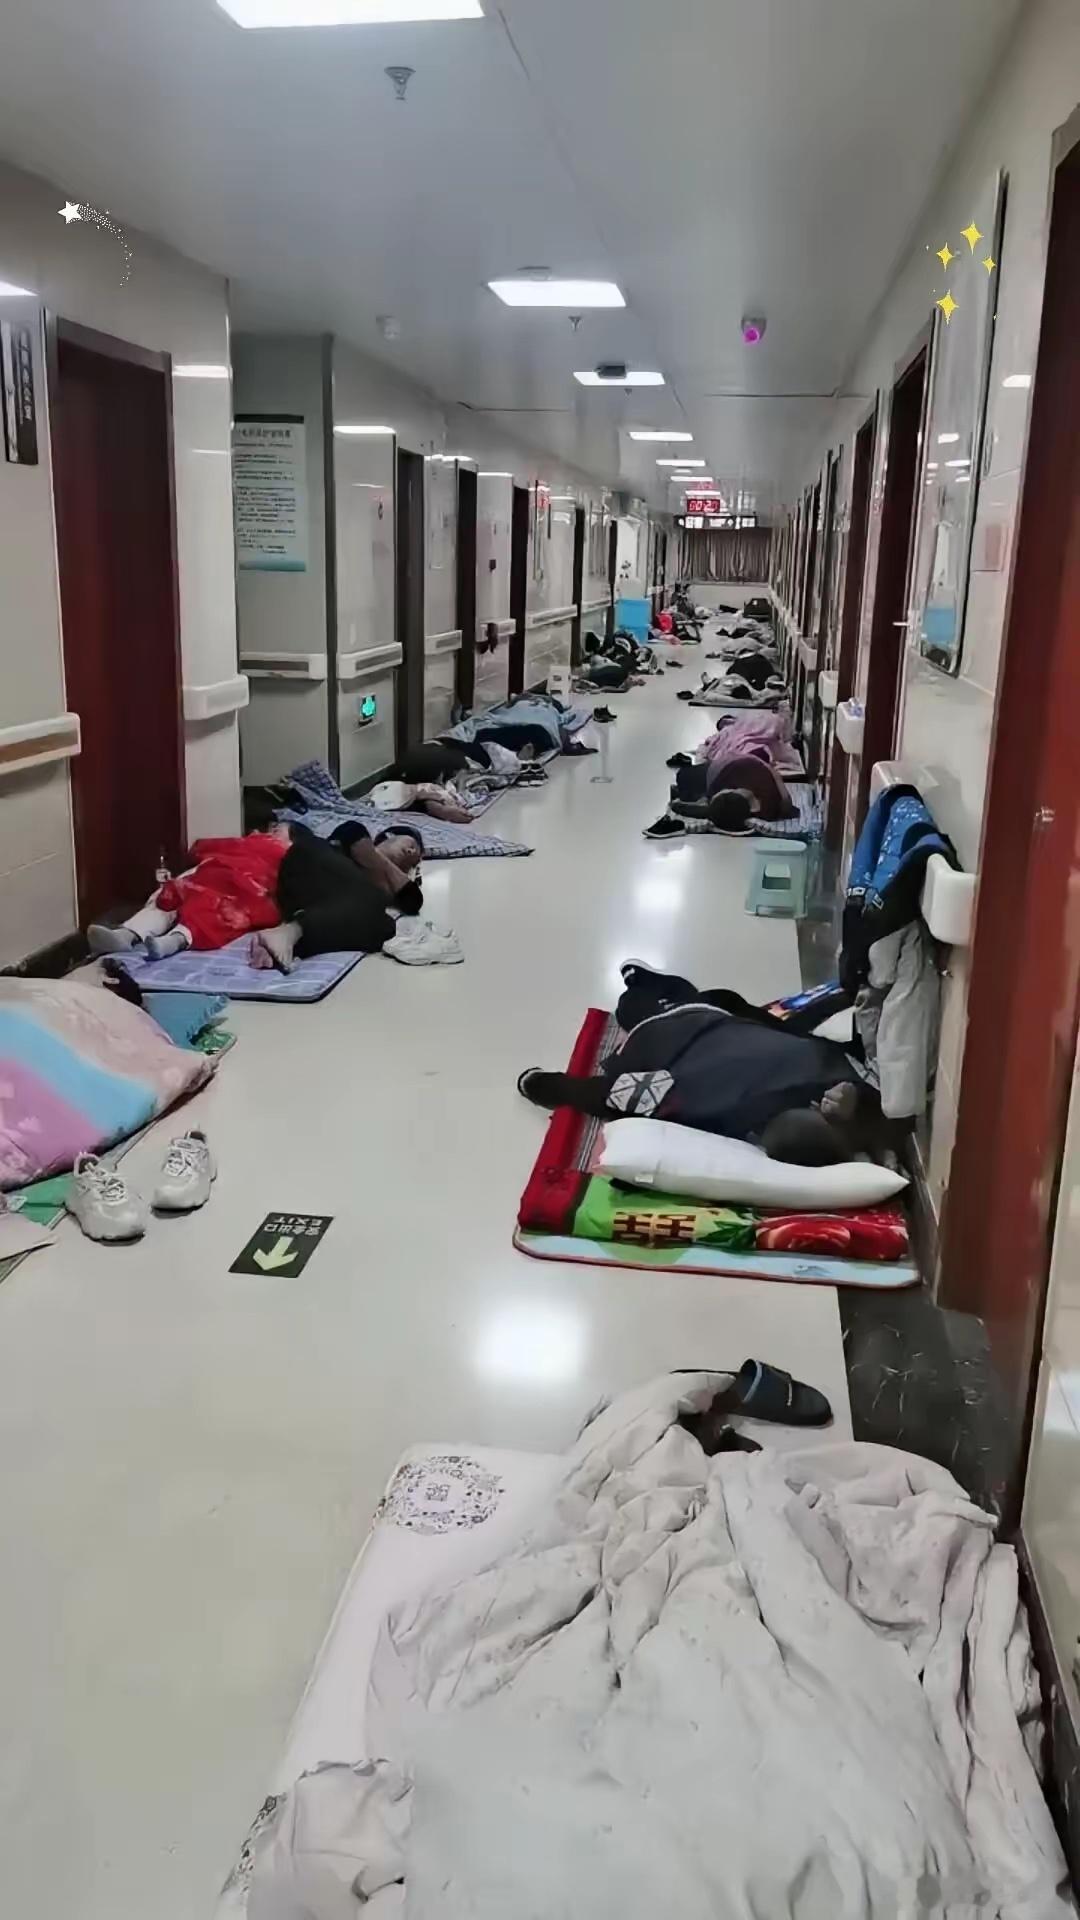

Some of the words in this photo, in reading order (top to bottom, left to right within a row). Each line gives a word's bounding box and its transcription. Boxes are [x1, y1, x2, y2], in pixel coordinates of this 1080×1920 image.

[273, 1217, 322, 1226] EXIT
[264, 1224, 320, 1235] 安全出口
